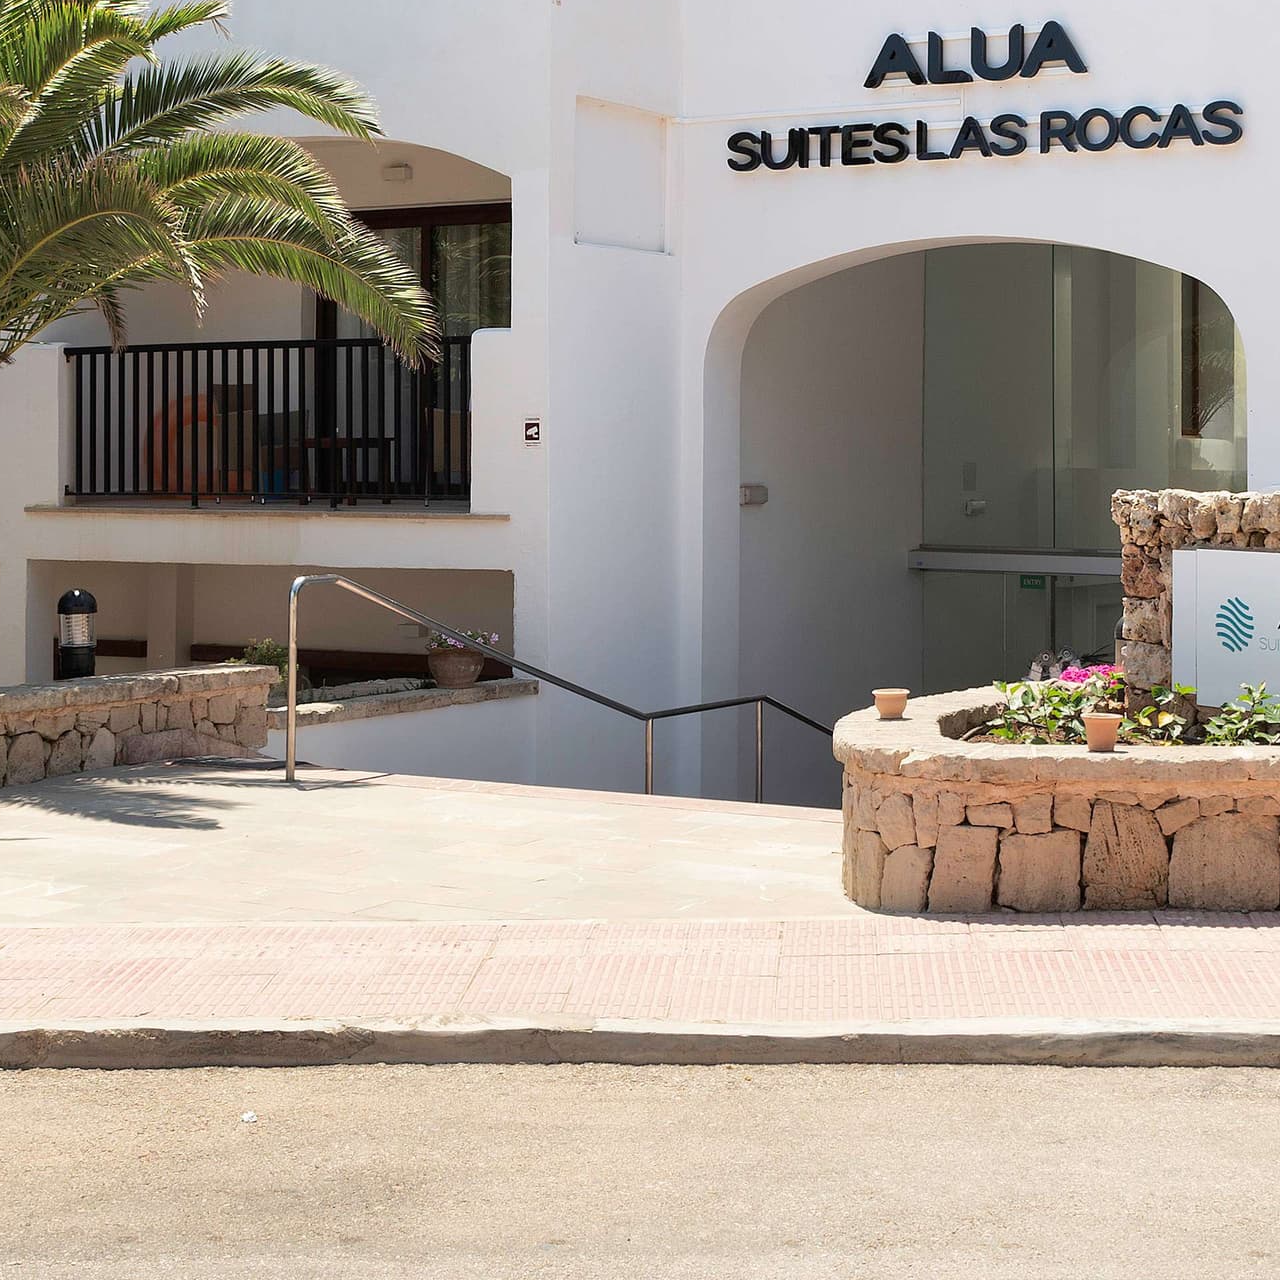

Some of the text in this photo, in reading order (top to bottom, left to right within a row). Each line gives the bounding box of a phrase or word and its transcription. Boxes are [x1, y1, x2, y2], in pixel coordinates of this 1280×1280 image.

[863, 20, 1088, 88] ALUA
[726, 99, 1245, 172] SUITES LAS ROCAS
